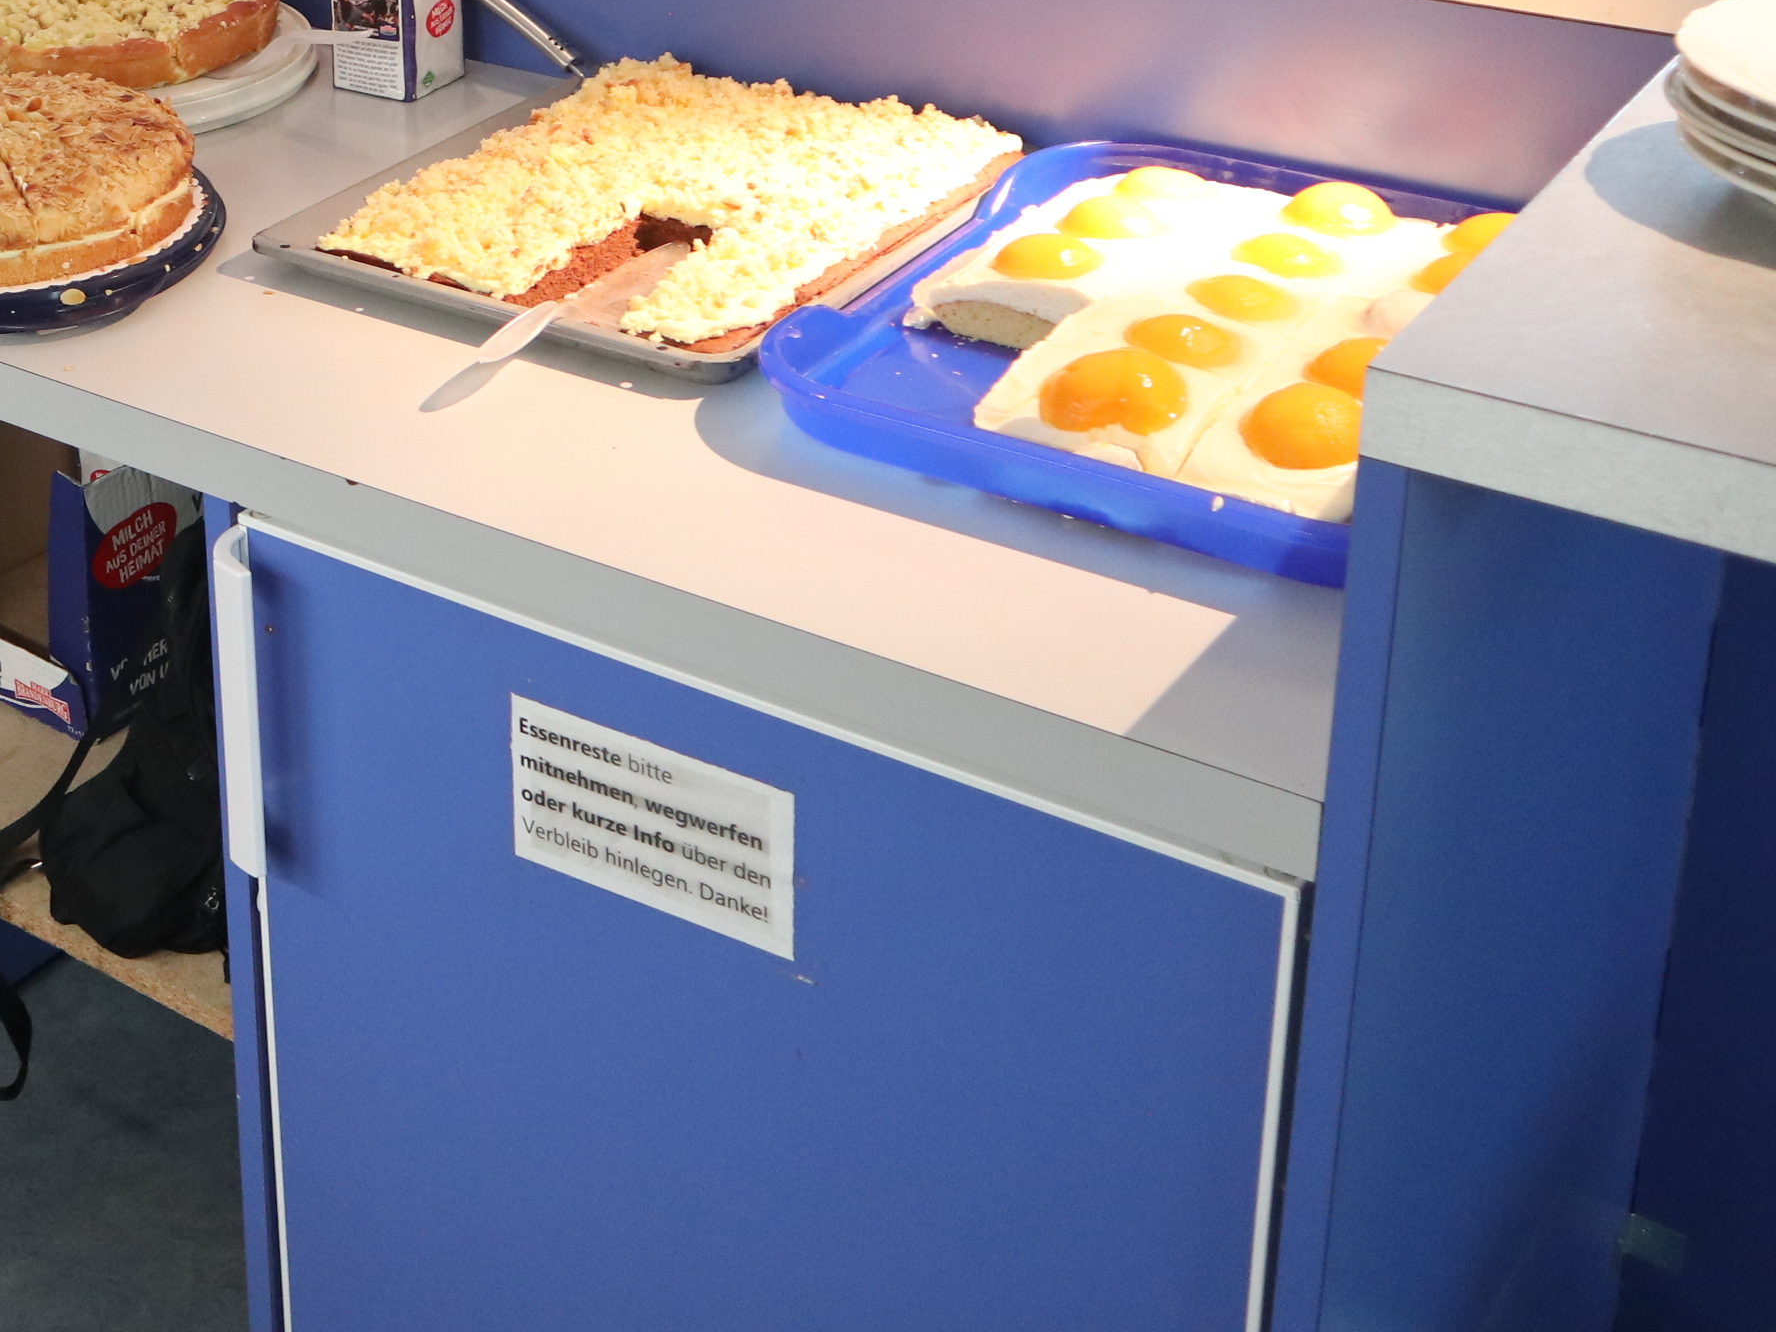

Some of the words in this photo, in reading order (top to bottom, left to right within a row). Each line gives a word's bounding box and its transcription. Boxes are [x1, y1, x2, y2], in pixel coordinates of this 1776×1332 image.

[106, 550, 128, 574] AUS
[129, 520, 167, 557] DEINER
[111, 509, 154, 552] MILCH
[119, 538, 164, 584] HEIMAT
[518, 716, 622, 767] Essenreste
[627, 753, 673, 785] bitte
[520, 752, 640, 810] mitnehmen,
[644, 798, 764, 852] wegwerfen
[521, 786, 566, 815] oder
[572, 801, 627, 837] kurze
[633, 824, 675, 854] Info
[682, 842, 727, 873] über
[733, 862, 772, 890] den
[522, 815, 599, 860] Verbleib
[605, 846, 694, 895] hinlegen.
[699, 882, 770, 923] Danke!
